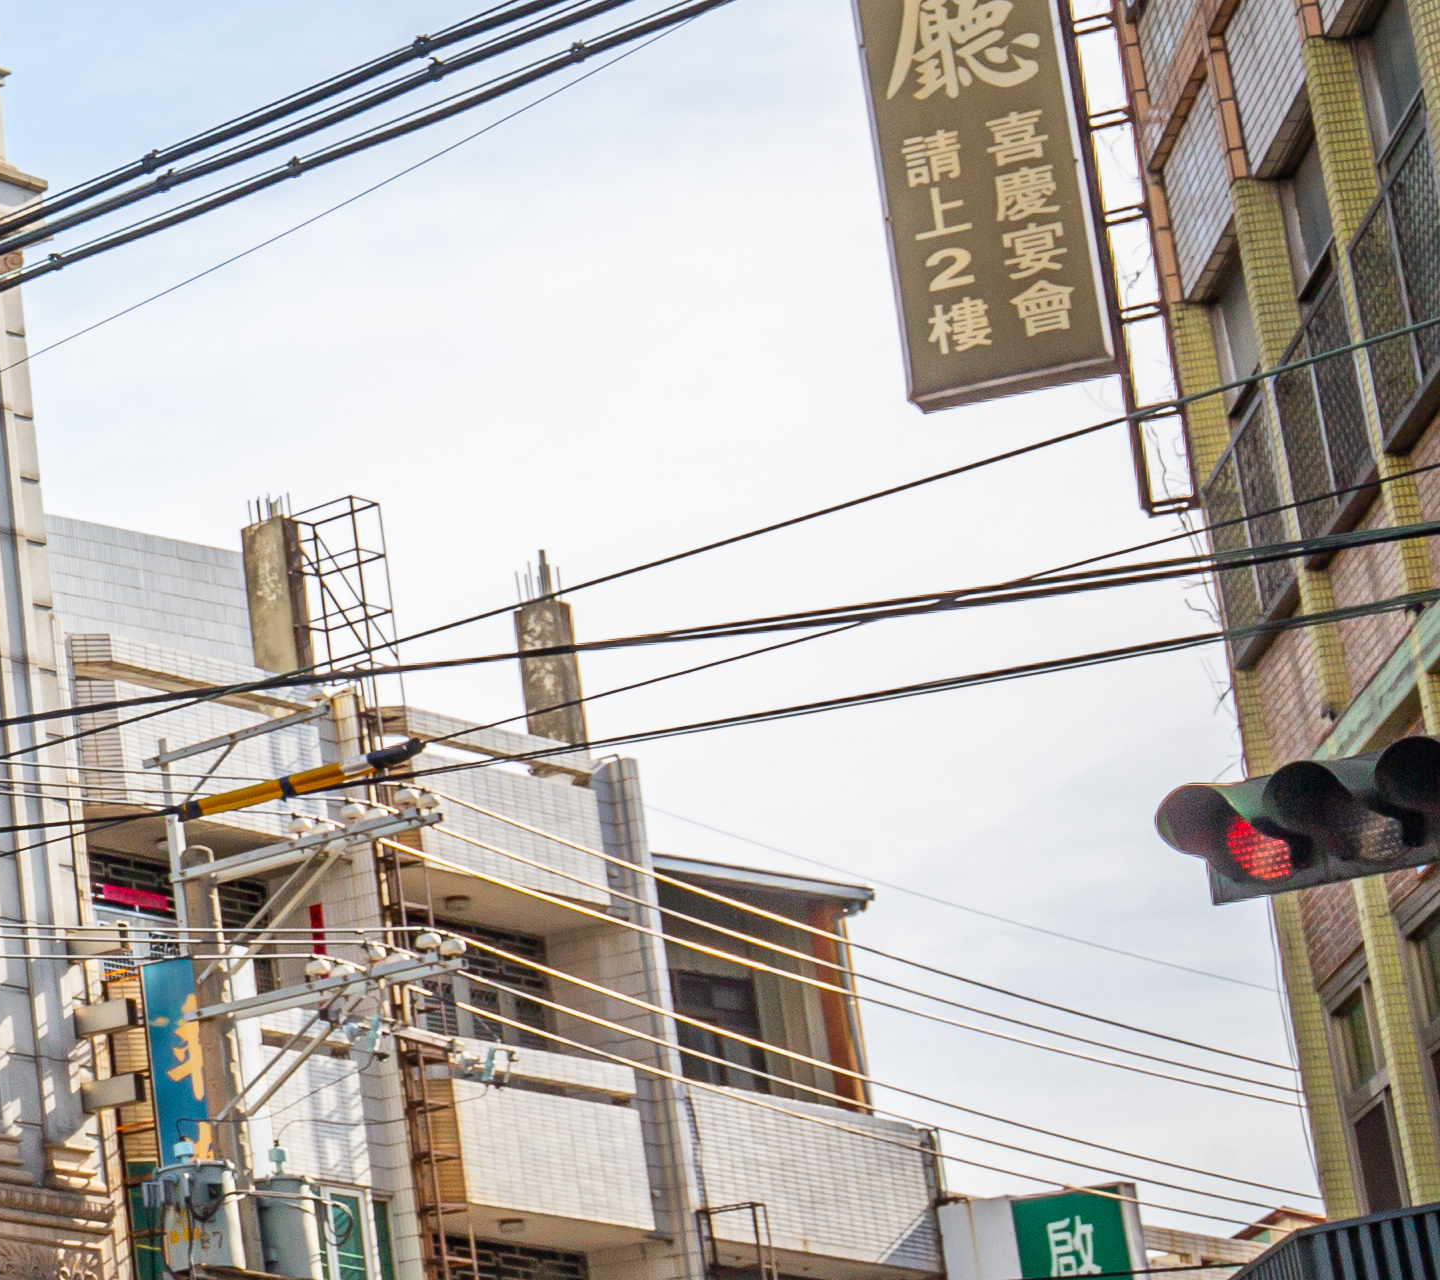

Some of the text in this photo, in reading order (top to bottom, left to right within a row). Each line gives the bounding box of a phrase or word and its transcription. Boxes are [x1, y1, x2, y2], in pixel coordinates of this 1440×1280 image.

[903, 128, 992, 358] 請上2樓
[985, 110, 1077, 340] 喜慶宴會
